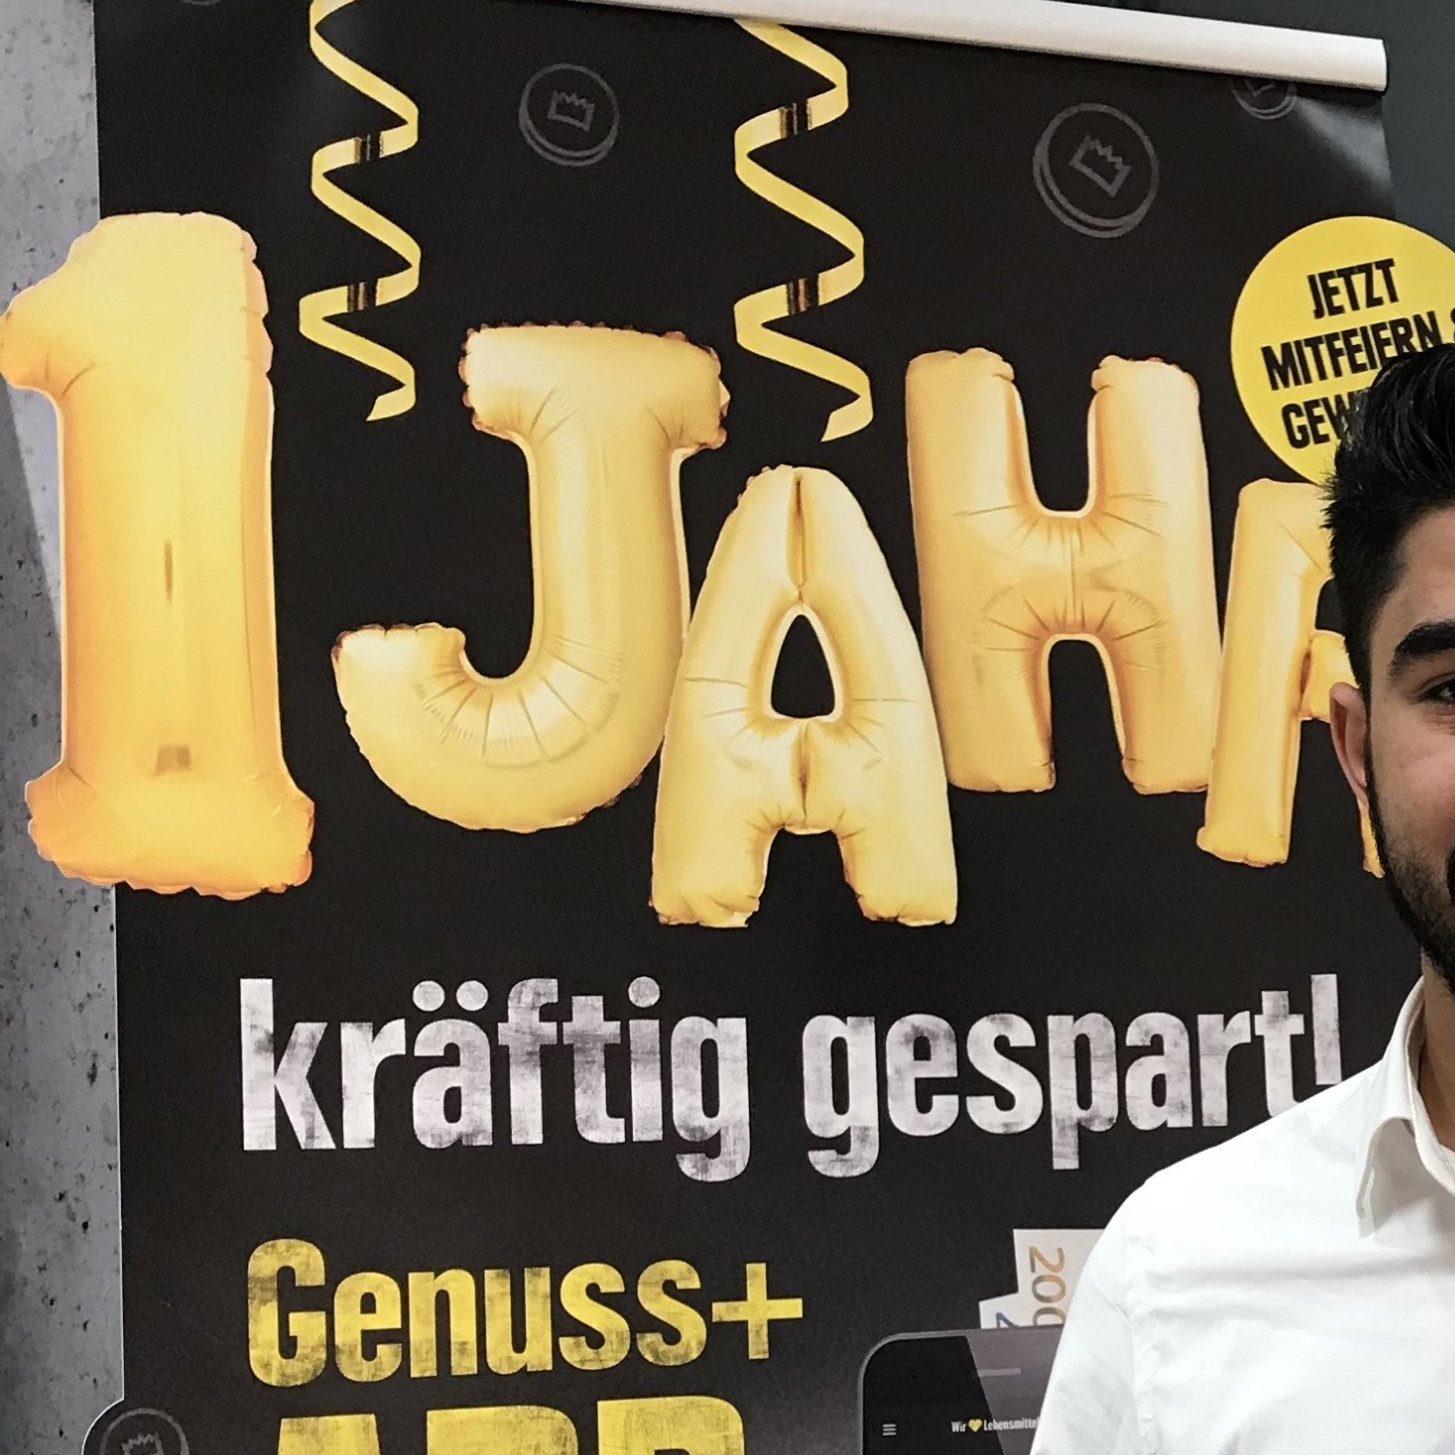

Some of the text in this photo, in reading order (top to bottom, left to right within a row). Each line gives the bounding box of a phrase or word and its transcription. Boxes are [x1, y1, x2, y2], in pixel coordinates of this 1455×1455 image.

[1307, 258, 1399, 319] JETZT
[1261, 310, 1442, 391] MITFEIERN
[0, 211, 313, 898] 1
[240, 976, 750, 1182] kräftig
[247, 1238, 803, 1387] Genuss+
[951, 1420, 967, 1433] Wir
